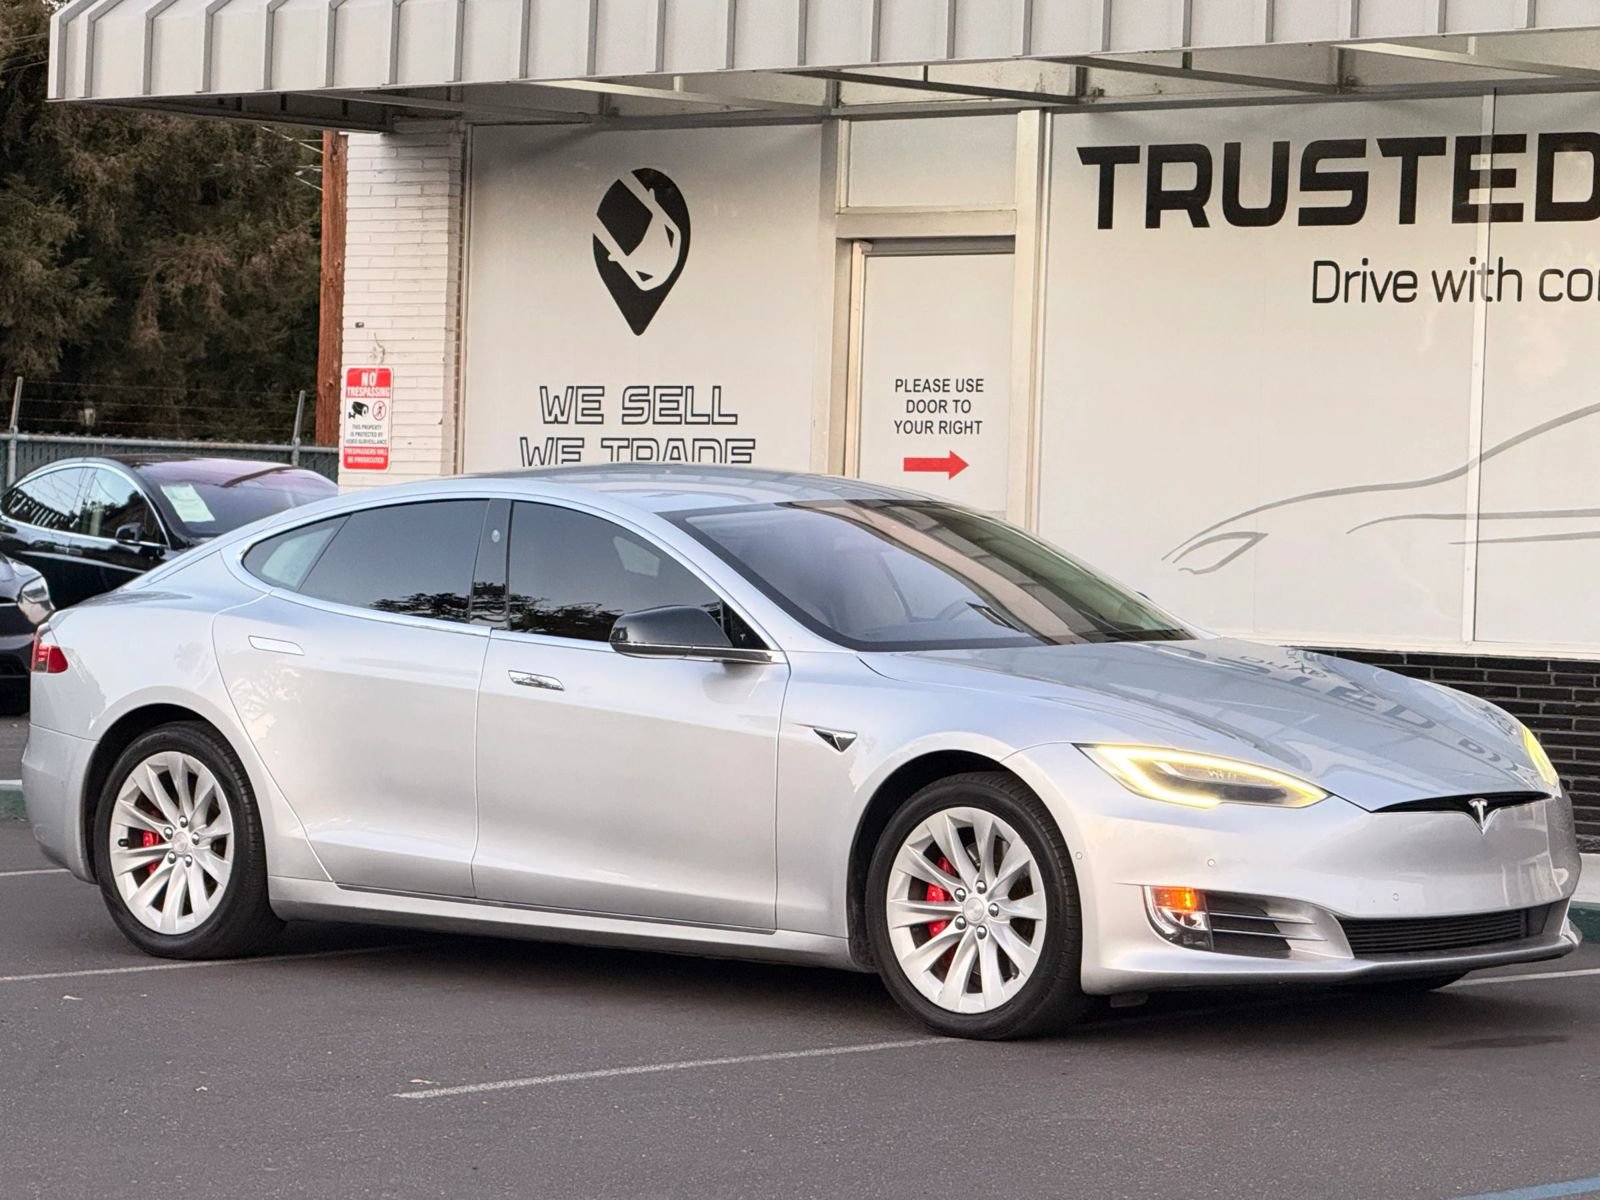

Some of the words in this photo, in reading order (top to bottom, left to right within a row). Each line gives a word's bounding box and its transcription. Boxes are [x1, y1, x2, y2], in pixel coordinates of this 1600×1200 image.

[1076, 132, 1600, 230] TRUSTED
[1312, 257, 1418, 304] Drive
[1431, 256, 1523, 303] with
[1538, 268, 1600, 302] co
[361, 372, 377, 387] NO
[895, 378, 951, 393] PLEASE
[955, 378, 984, 393] USE
[539, 385, 605, 425] WE
[621, 385, 738, 425] SELL
[906, 399, 948, 414] DOOR
[952, 399, 972, 414] TO
[894, 420, 934, 435] YOUR
[938, 420, 983, 435] RIGHT
[519, 436, 585, 467] WE
